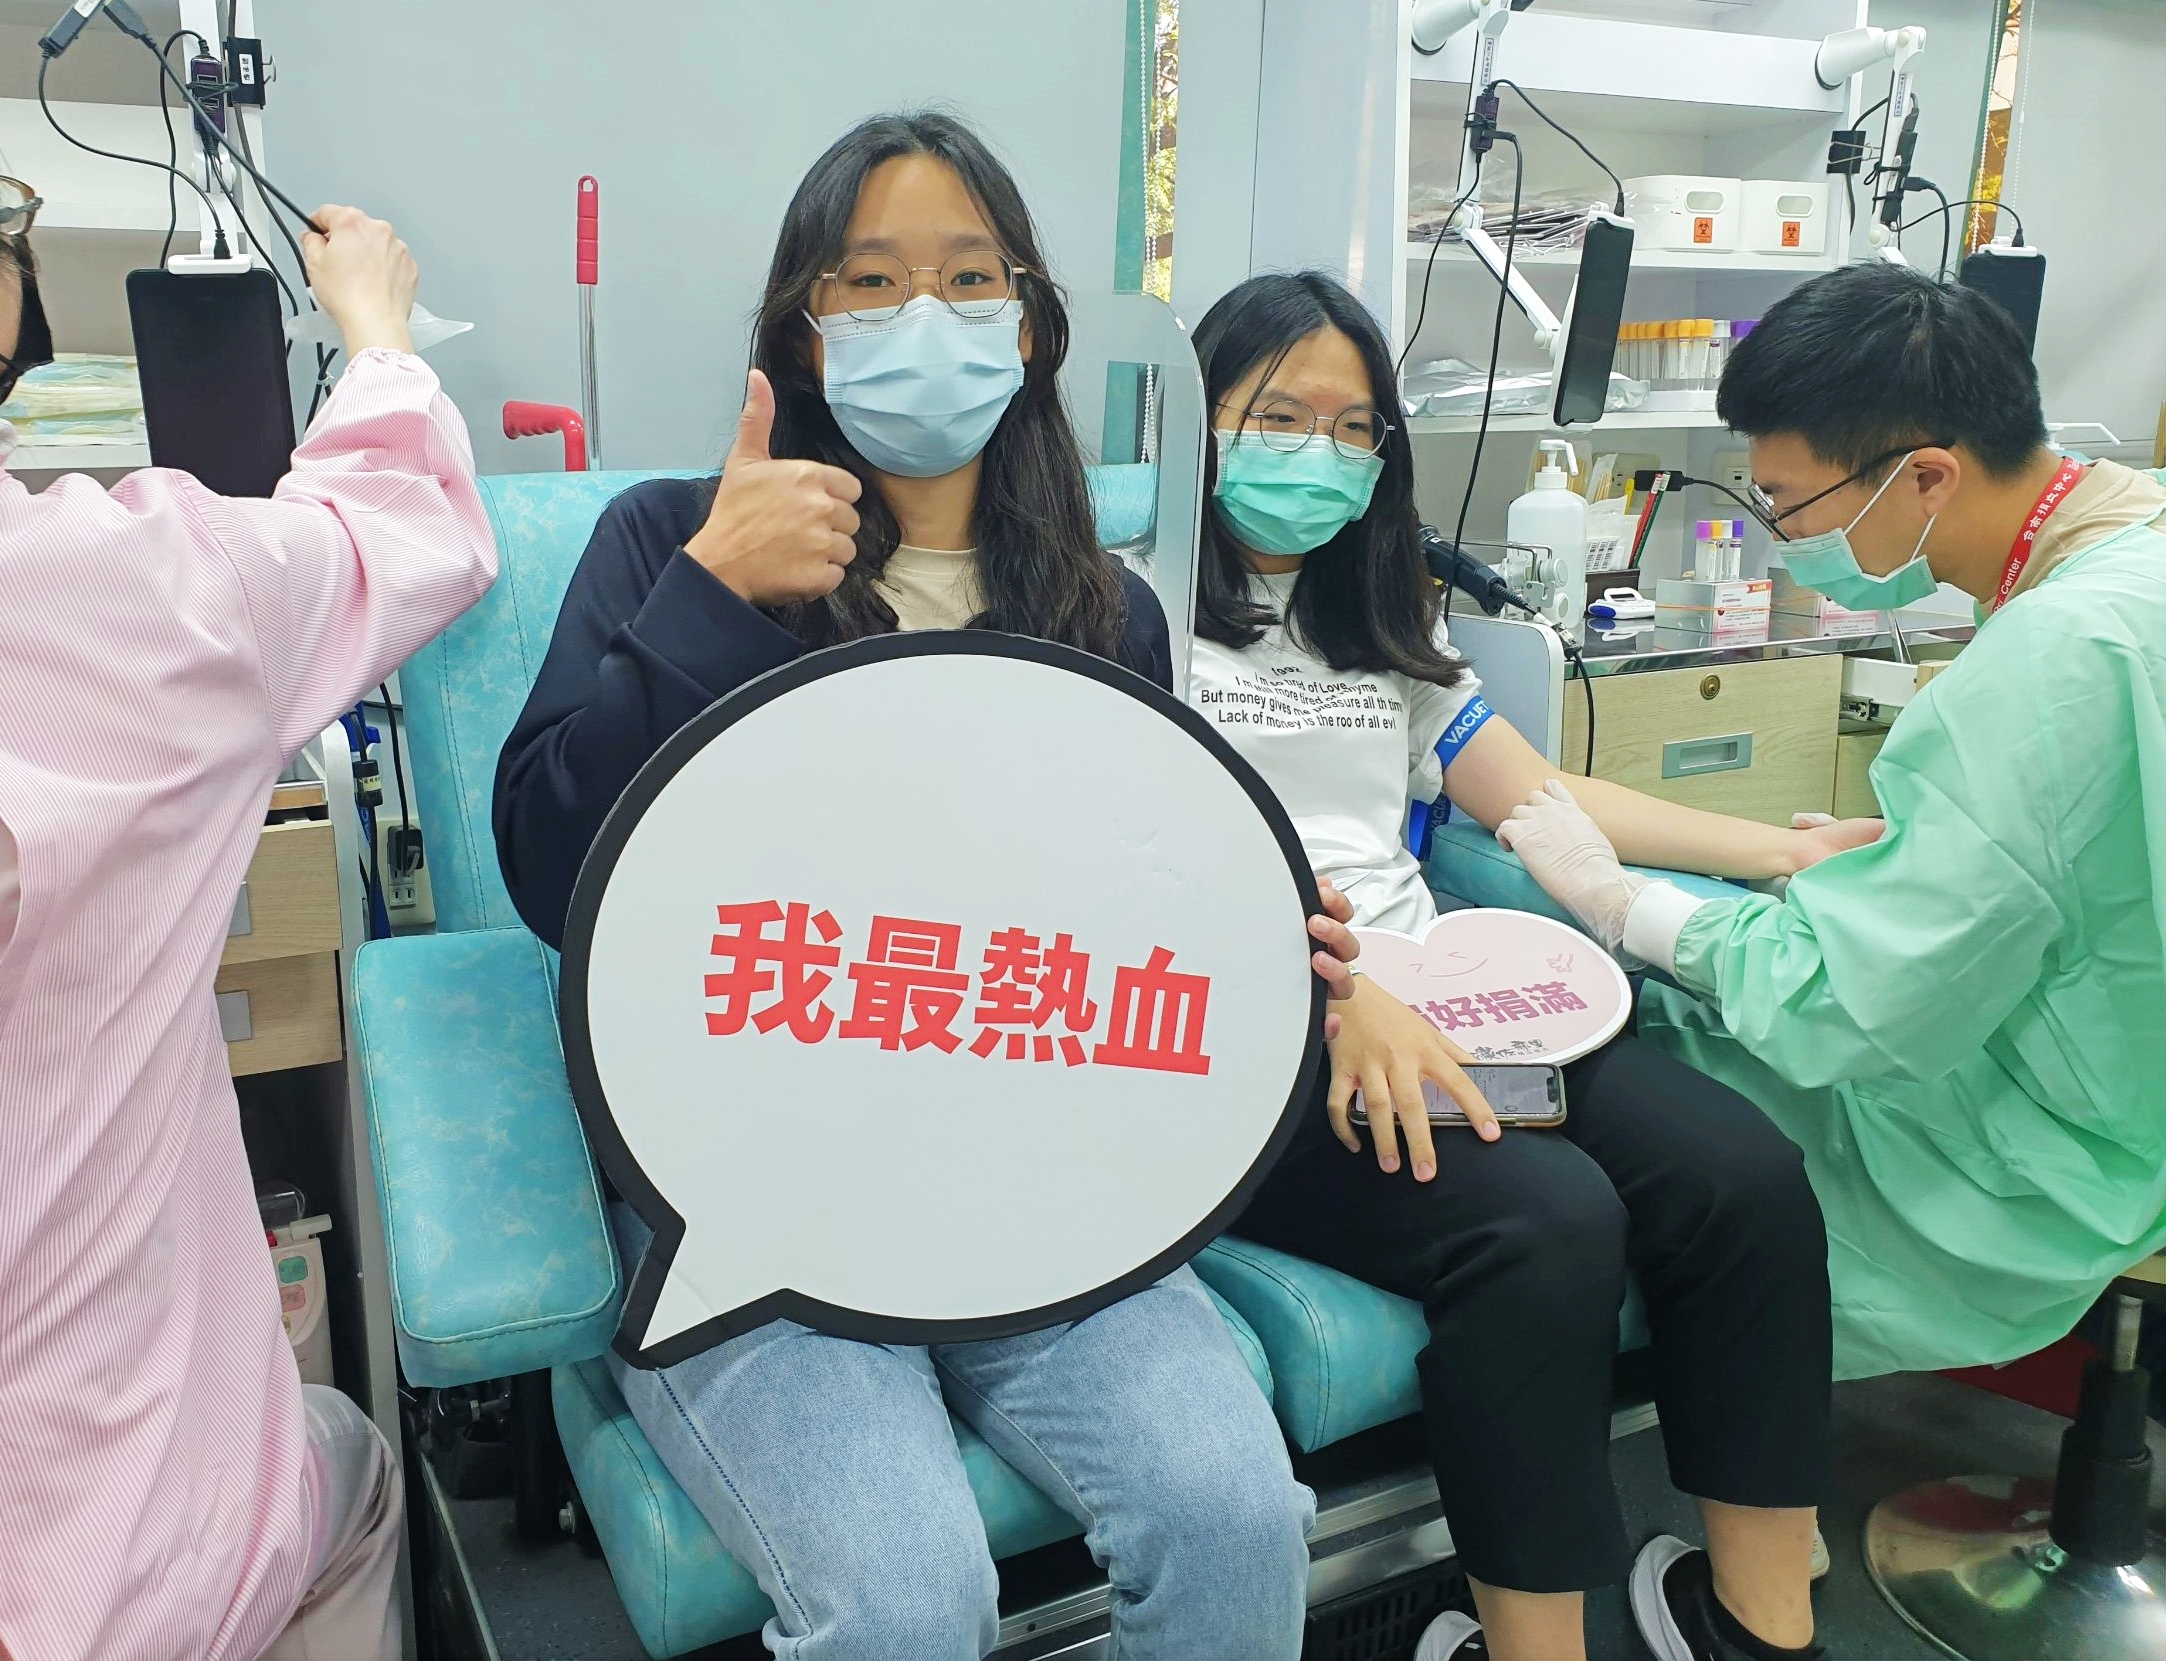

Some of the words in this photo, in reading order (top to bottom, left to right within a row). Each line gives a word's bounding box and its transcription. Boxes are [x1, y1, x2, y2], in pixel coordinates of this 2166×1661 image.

[2001, 557, 2022, 595] Center
[1275, 688, 1299, 701] more
[1299, 692, 1323, 706] tired
[1308, 682, 1319, 693] of
[1319, 682, 1347, 694] Love
[1201, 689, 1224, 704] But
[1226, 692, 1266, 709] money
[1269, 697, 1292, 715] gives
[1363, 696, 1376, 710] all
[1218, 709, 1249, 724] Lack
[1252, 711, 1264, 725] of
[1266, 716, 1302, 730] money
[1302, 717, 1316, 727] is
[1317, 714, 1335, 728] the
[1354, 714, 1366, 729] of
[1368, 715, 1381, 729] all
[704, 899, 1212, 1076] 我最熱血
